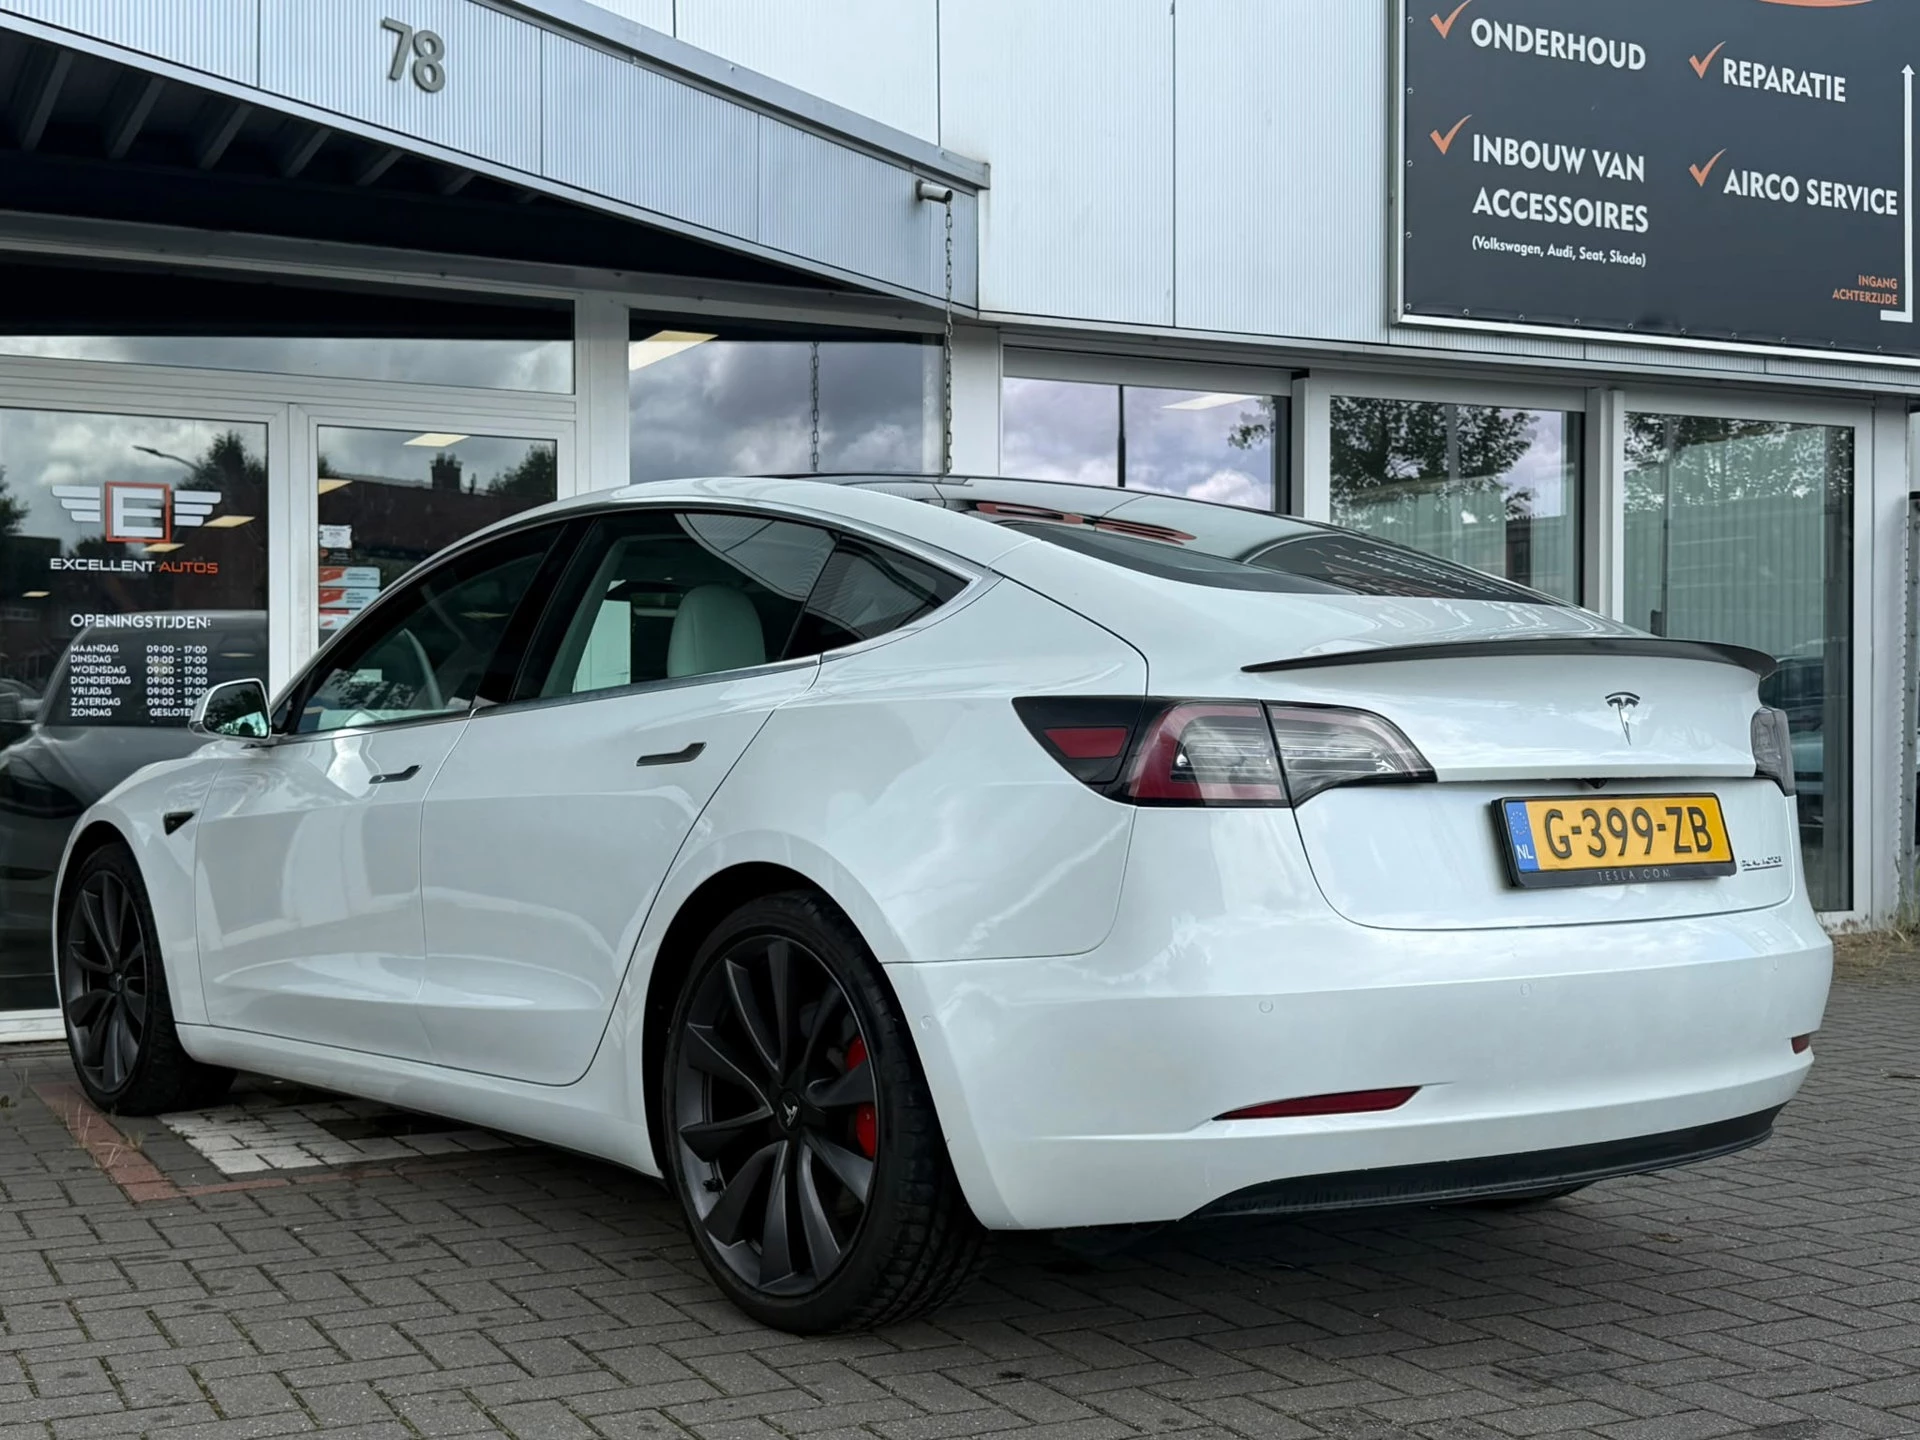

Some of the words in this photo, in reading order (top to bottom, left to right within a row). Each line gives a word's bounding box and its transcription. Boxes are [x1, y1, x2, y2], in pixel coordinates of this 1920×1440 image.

[1471, 18, 1646, 70] ONDERHOUD
[380, 16, 446, 93] 78
[1723, 57, 1846, 102] REPARATIE
[1473, 134, 1586, 175] INBOUW
[1592, 149, 1645, 183] VAN
[1723, 168, 1800, 203] AIRCO
[1806, 178, 1898, 216] SERVICE
[1472, 186, 1649, 233] ACCESSOIRES
[1472, 235, 1544, 257] (Volkswagen,
[1547, 244, 1577, 261] Audi,
[1579, 247, 1607, 264] Seat,
[1609, 250, 1647, 268] Skoda)
[1858, 274, 1898, 289] INGANG
[1832, 288, 1898, 306] ACHTERZIJDE
[113, 486, 163, 538] E
[50, 557, 155, 572] EXCELLENT
[158, 561, 219, 574] AUTOS
[70, 614, 212, 629] OPENINGSTIJDEN:
[70, 645, 119, 653] MAANDAG
[146, 645, 175, 653] 09:00
[184, 645, 208, 654] 17:00
[70, 655, 112, 663] DINSDAG
[146, 655, 175, 663] 09:00
[184, 655, 208, 664] 17:00
[70, 666, 127, 674] WOENSDAG
[146, 666, 175, 674] 09:00
[184, 666, 208, 675] 17:00
[70, 676, 131, 684] DONDERDAG
[146, 676, 175, 684] 09:00
[184, 676, 208, 685] 17:00
[70, 687, 112, 695] VRIJDAG
[146, 687, 175, 695] 09:00
[184, 687, 208, 696] 17:00
[70, 698, 121, 706] ZATERDAG
[146, 698, 175, 706] 09:00
[70, 708, 112, 716] ZONDAG
[1545, 807, 1712, 859] G-399-ZB
[1516, 845, 1534, 860] NL
